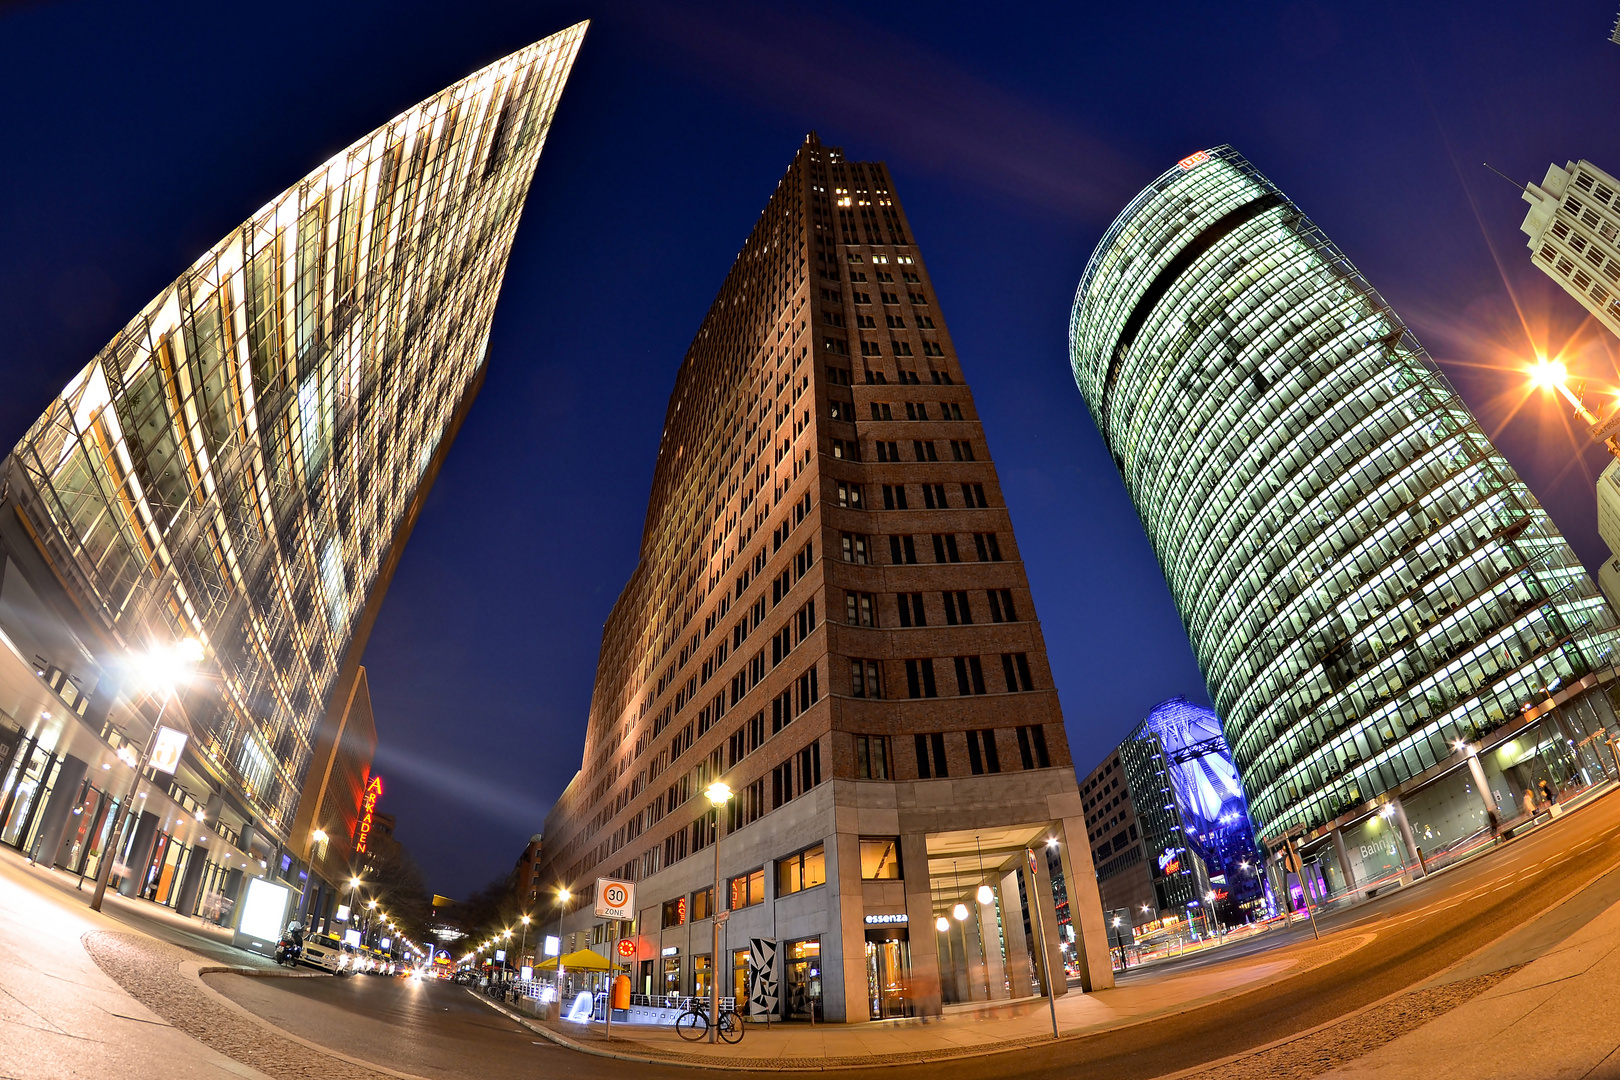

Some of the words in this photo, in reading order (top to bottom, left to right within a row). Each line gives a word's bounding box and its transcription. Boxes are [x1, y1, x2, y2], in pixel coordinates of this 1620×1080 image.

[1182, 152, 1206, 168] DB
[356, 776, 382, 854] ARKADEN
[608, 889, 623, 902] 30
[605, 907, 624, 916] ZONE
[865, 914, 908, 924] essenza
